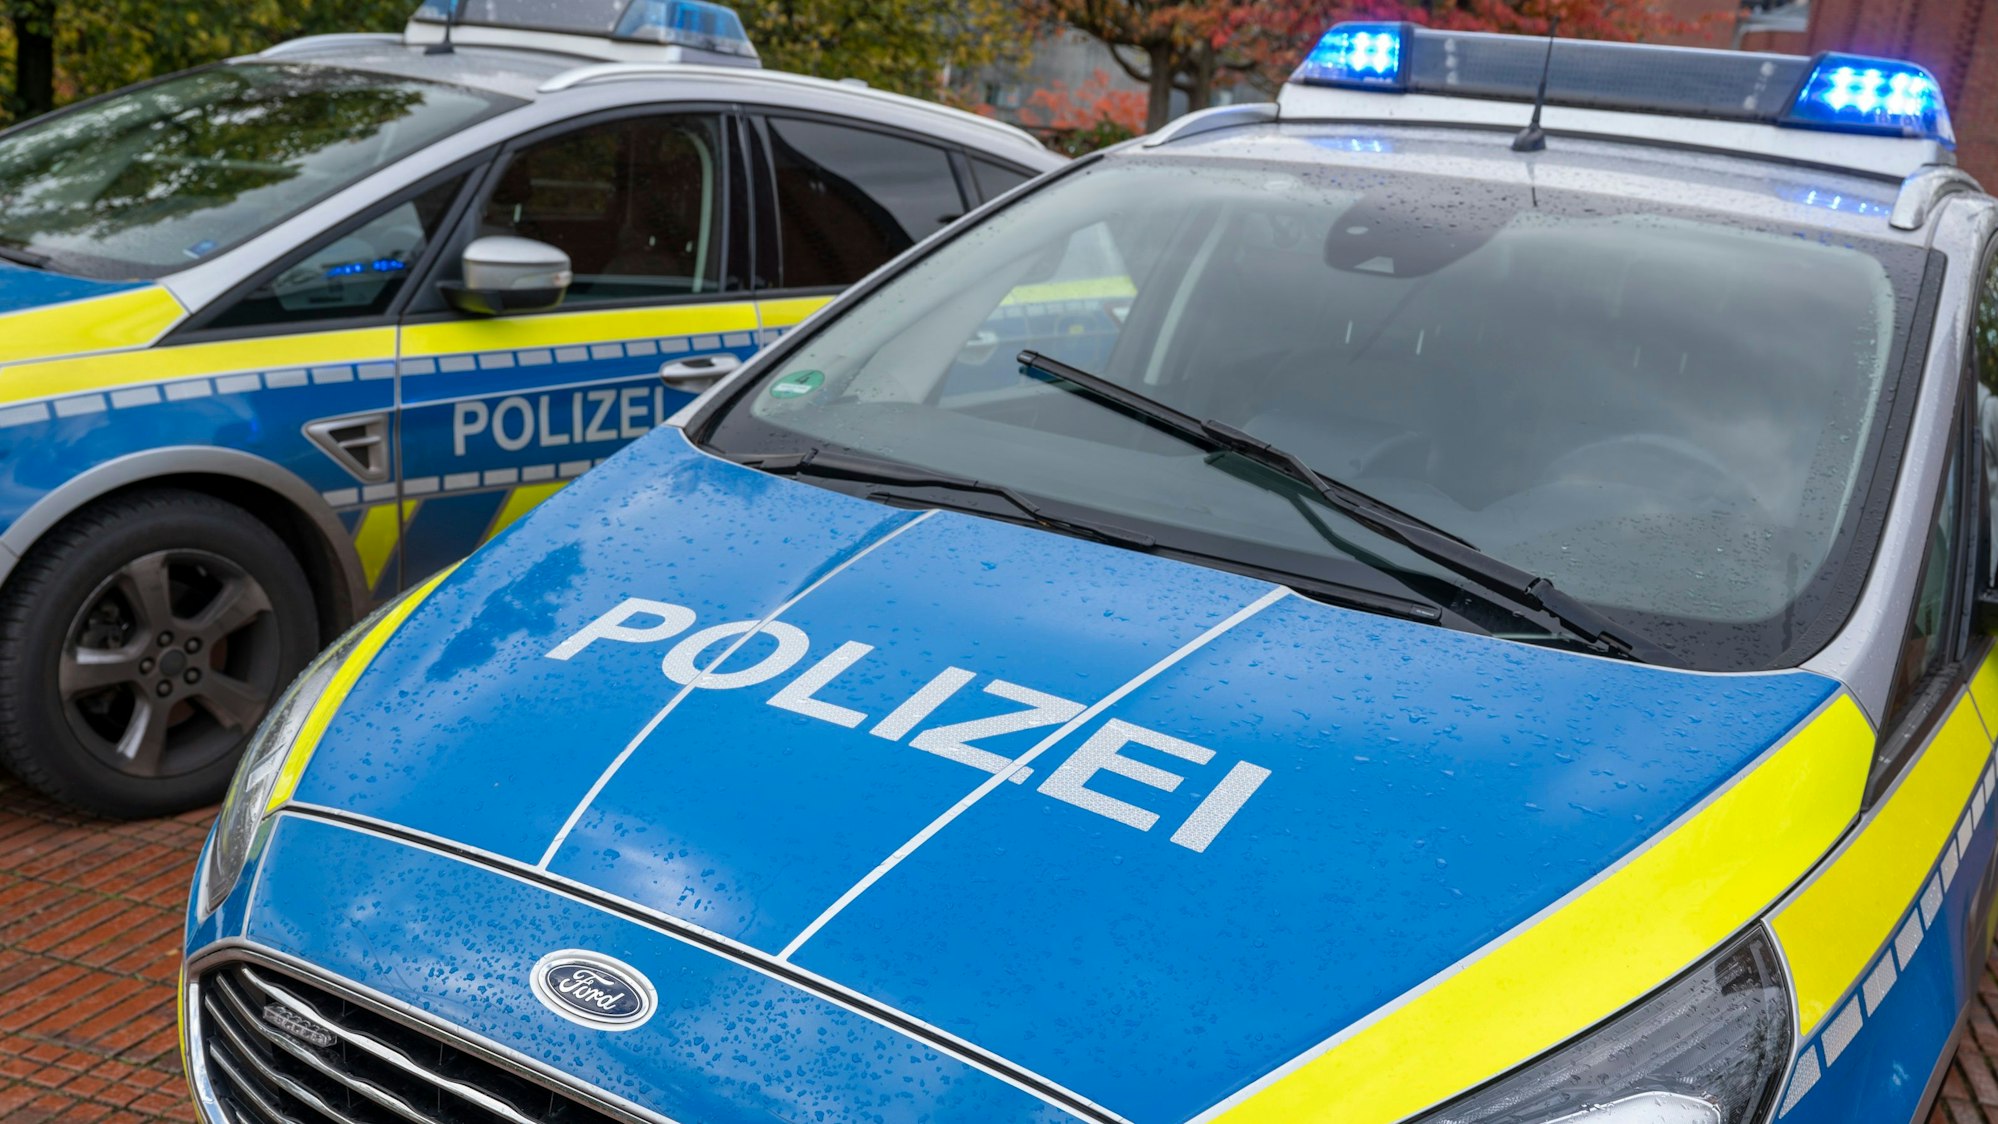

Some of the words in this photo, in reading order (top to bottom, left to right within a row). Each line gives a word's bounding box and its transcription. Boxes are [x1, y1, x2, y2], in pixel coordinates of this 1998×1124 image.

[453, 386, 664, 456] POLIZEI
[545, 597, 1272, 854] POLIZEI
[558, 969, 625, 1010] Ford
